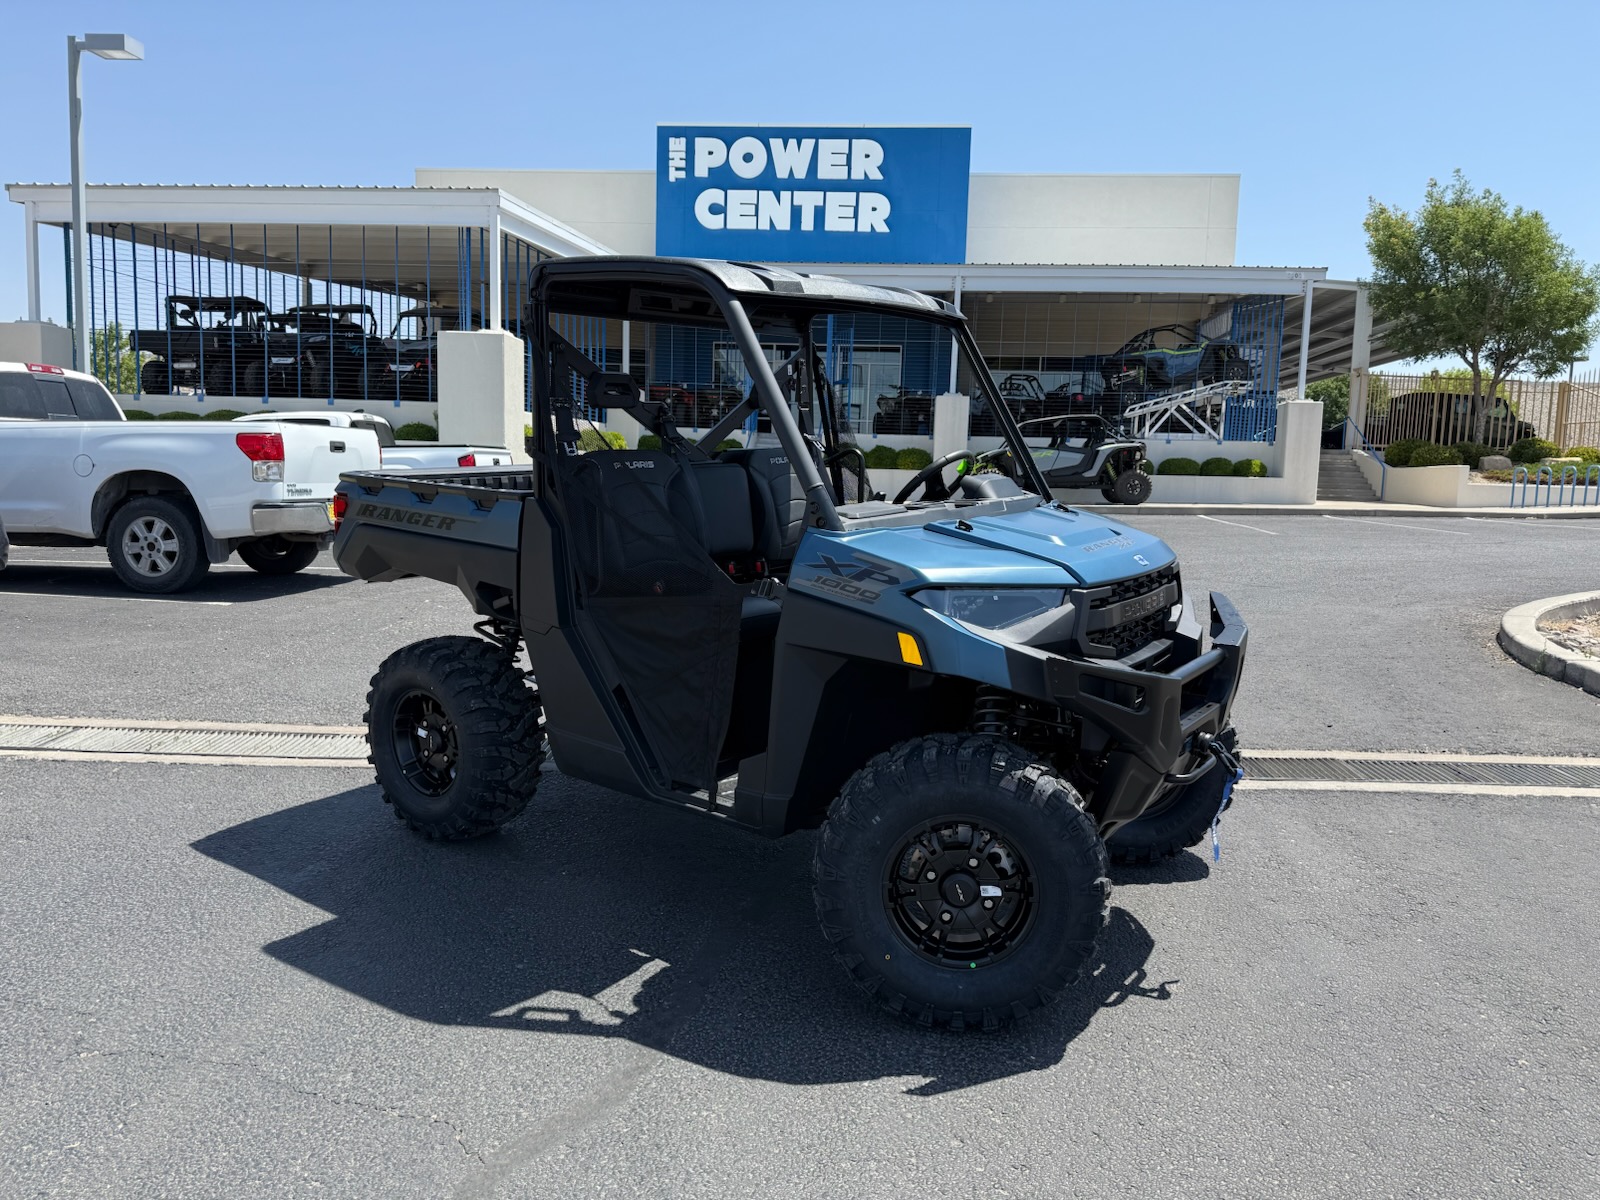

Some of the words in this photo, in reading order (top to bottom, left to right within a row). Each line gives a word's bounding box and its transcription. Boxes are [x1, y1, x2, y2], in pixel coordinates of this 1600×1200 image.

[668, 136, 687, 183] THE
[694, 136, 885, 181] POWER
[694, 188, 892, 233] CENTER
[769, 456, 790, 465] POLA
[358, 503, 457, 531] RANGER
[803, 551, 902, 586] XP
[812, 575, 882, 601] 1000
